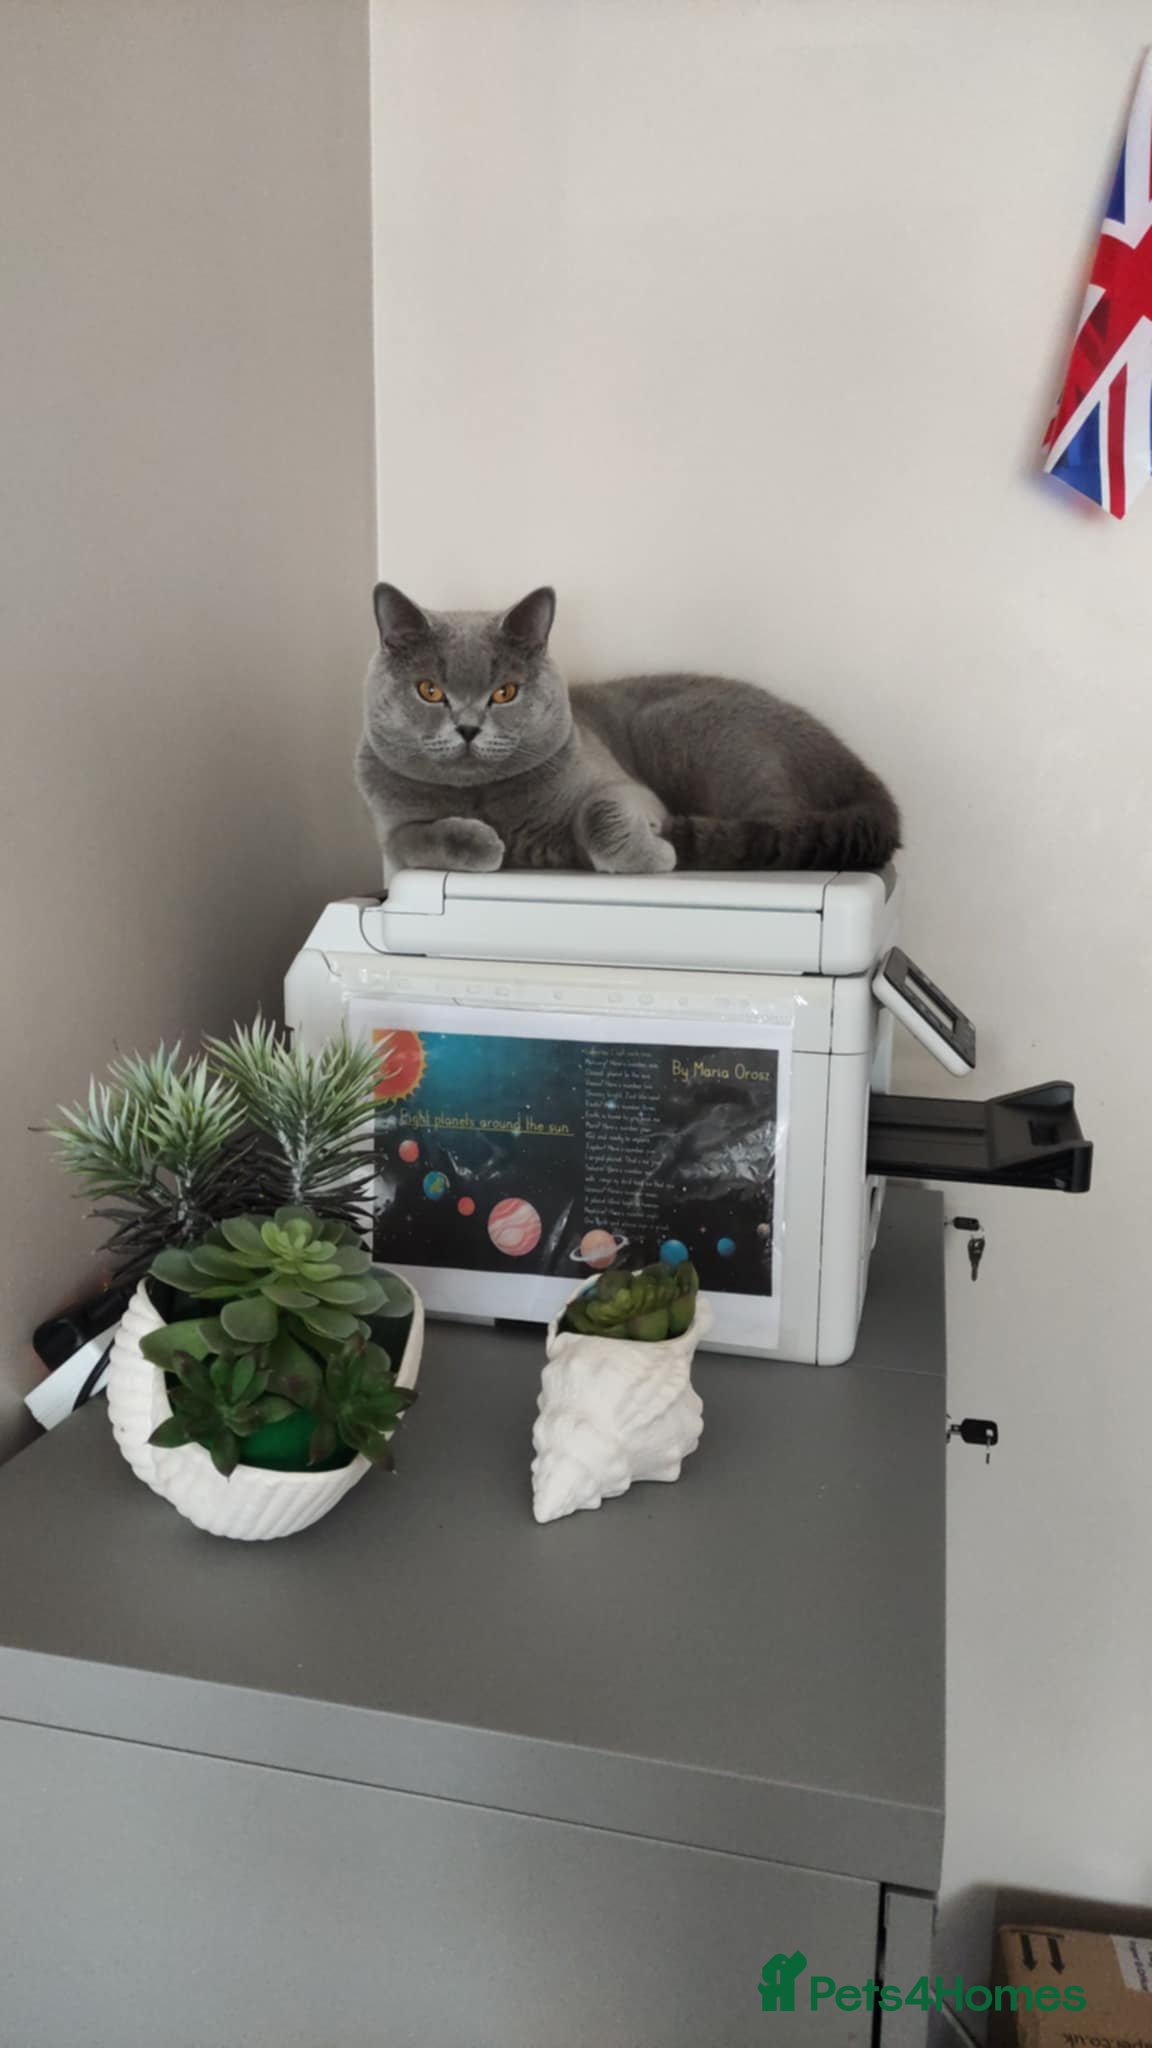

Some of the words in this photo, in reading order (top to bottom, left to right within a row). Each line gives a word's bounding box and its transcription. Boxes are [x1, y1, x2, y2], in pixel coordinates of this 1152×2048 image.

[672, 1060, 688, 1082] By
[693, 1061, 729, 1079] Maria
[434, 1112, 475, 1131] planets
[480, 1112, 521, 1130] around
[526, 1115, 545, 1132] the
[549, 1124, 569, 1134] sun
